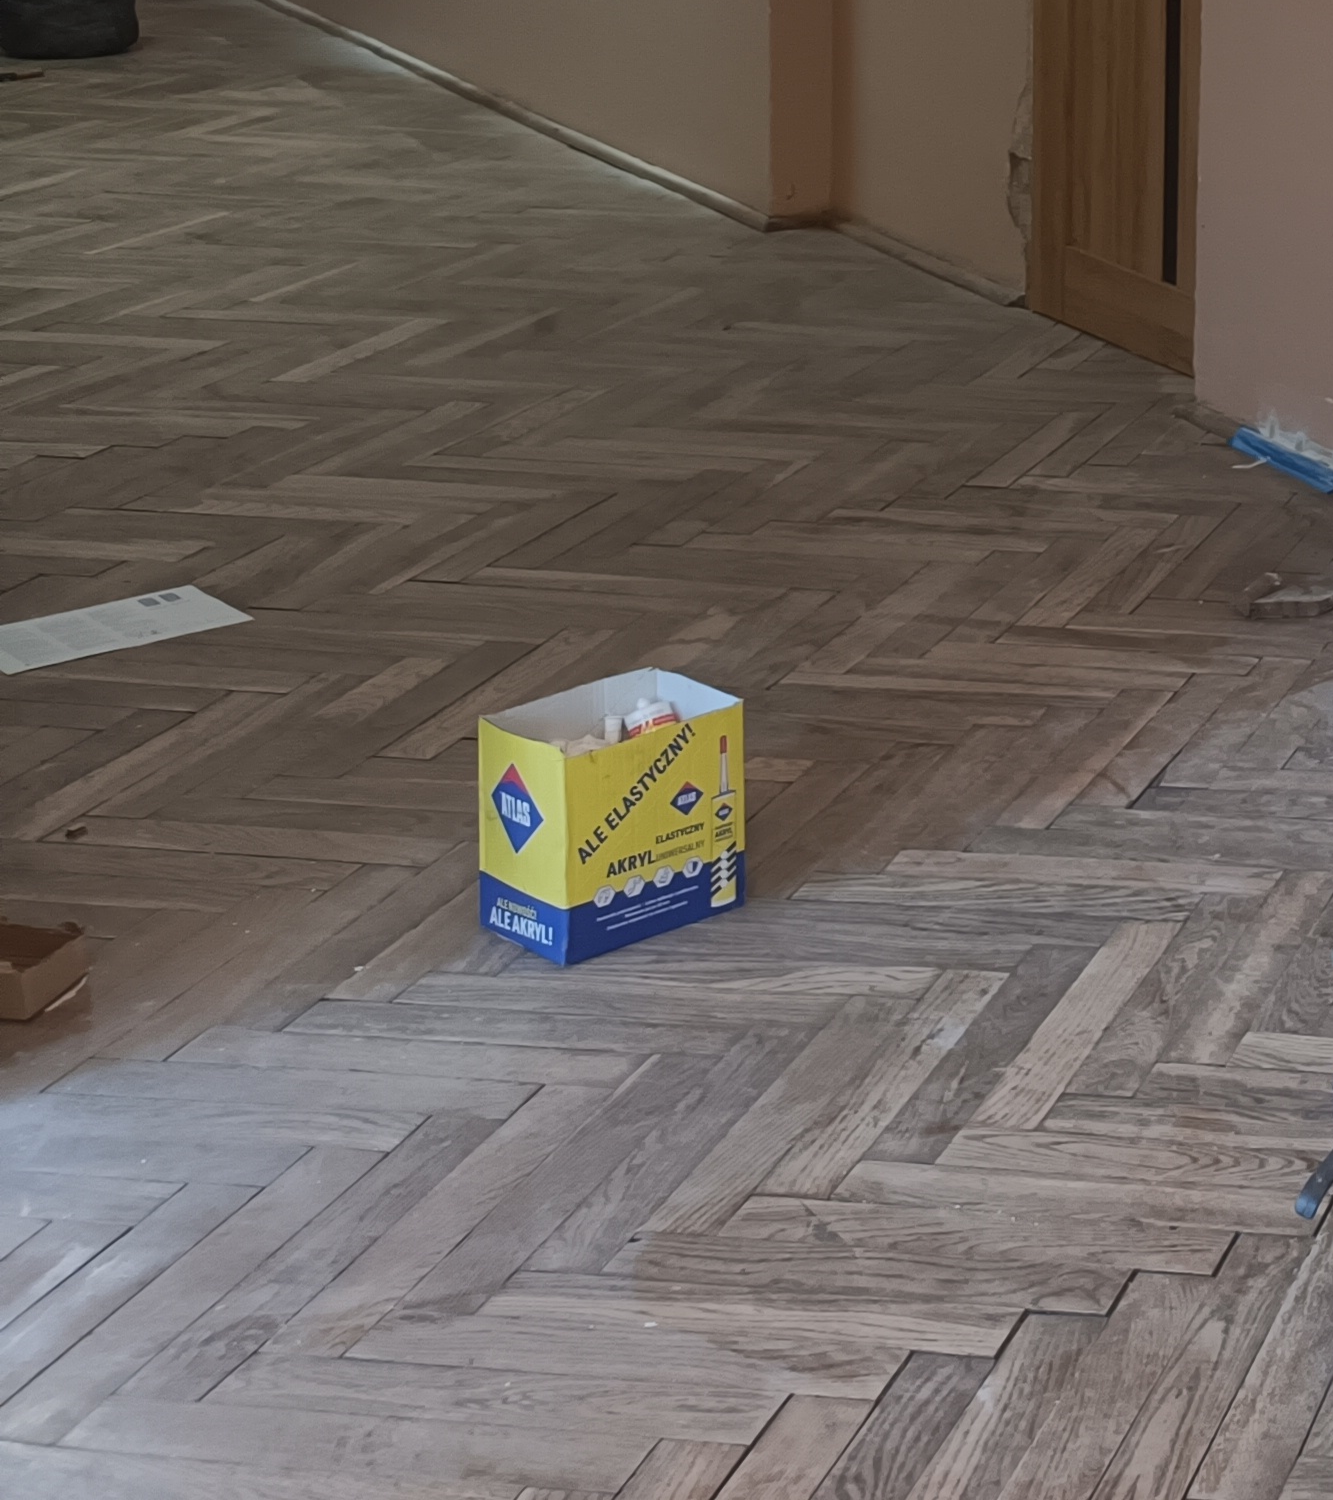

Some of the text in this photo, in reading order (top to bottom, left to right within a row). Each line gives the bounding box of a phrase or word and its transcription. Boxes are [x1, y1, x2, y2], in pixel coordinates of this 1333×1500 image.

[499, 790, 531, 828] ATLAS
[576, 825, 609, 865] ALE
[604, 722, 697, 831] ELASTYCZNY!
[655, 822, 705, 845] ELASTYCZNY
[606, 849, 656, 879] AKRYL
[489, 905, 553, 946] ALE AKRYL!
